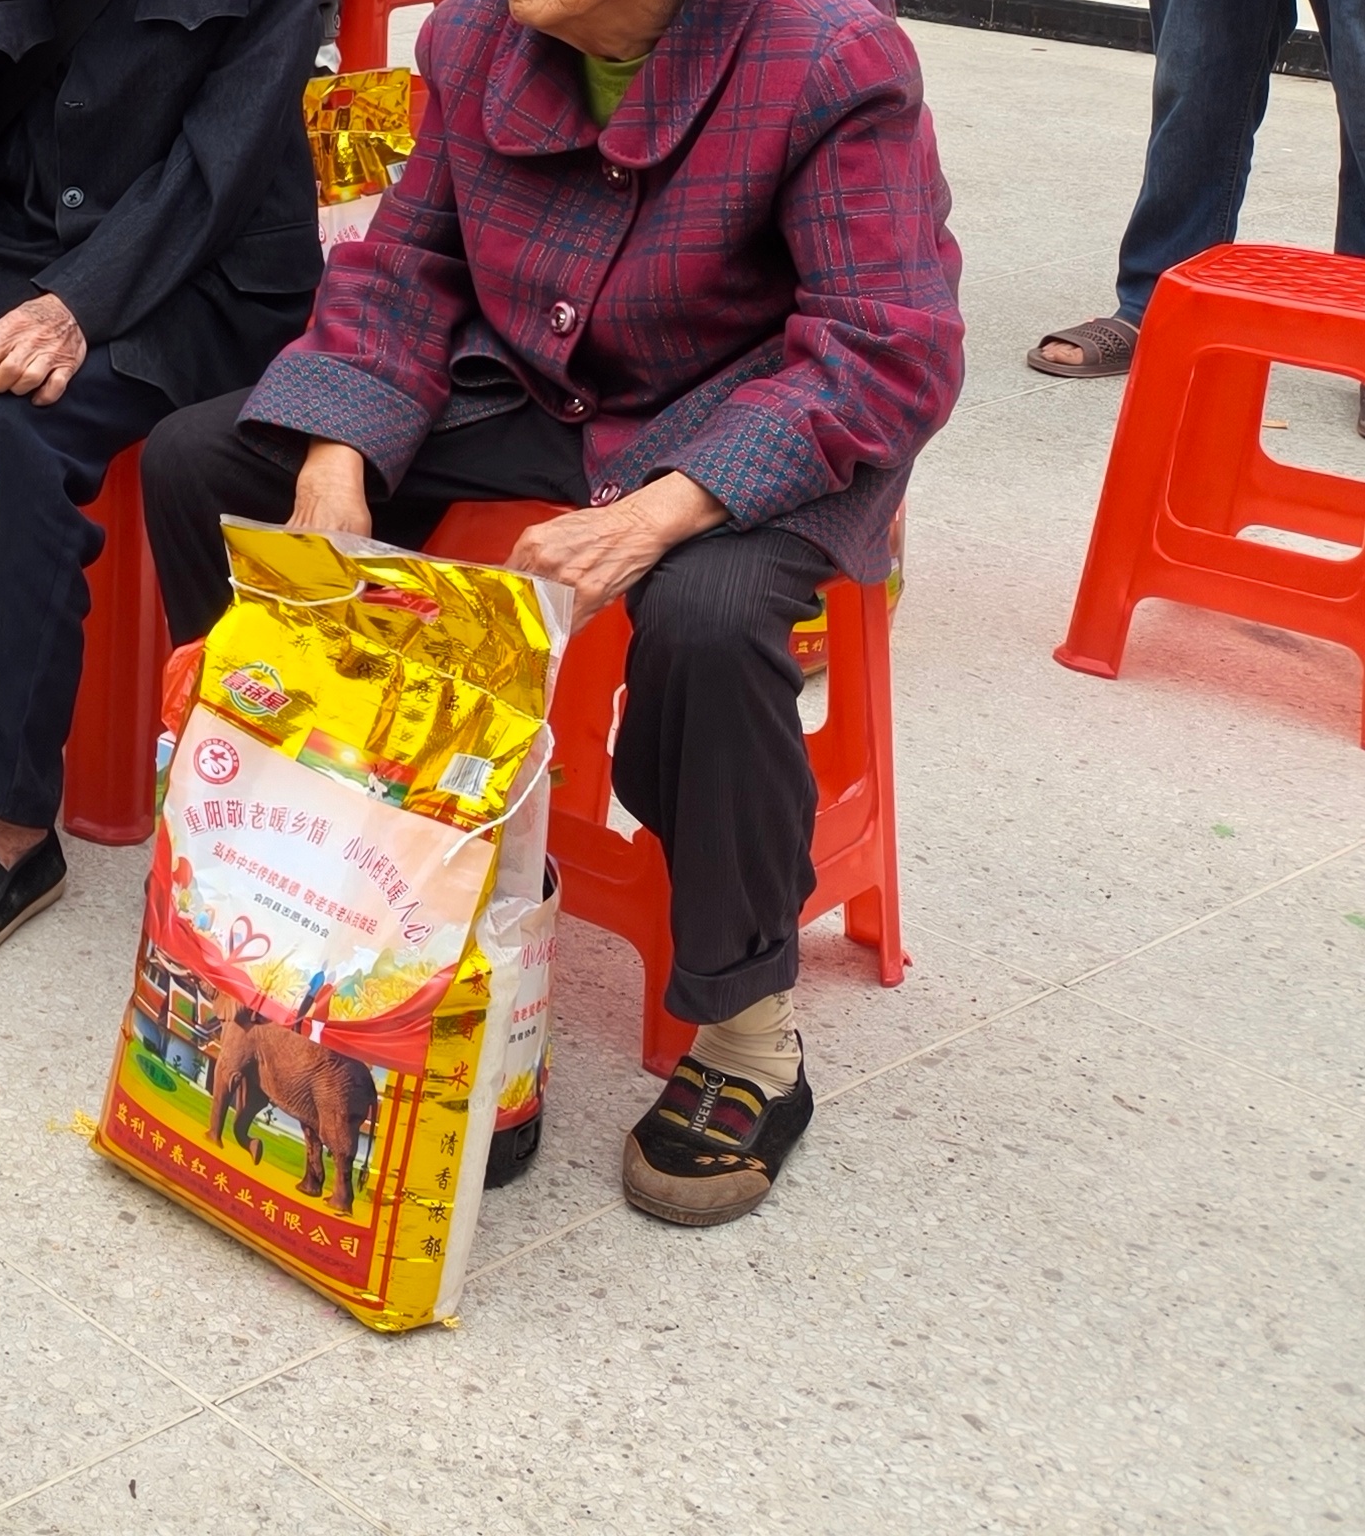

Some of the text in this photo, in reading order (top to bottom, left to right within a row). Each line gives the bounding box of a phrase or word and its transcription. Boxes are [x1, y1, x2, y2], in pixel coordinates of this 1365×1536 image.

[182, 799, 437, 945] 重阳敬老暖乡情 小小相聚暖人心
[211, 840, 379, 936] 弘扬中华传统美德 敬老爱老从我做起
[252, 891, 331, 940] 会同县志愿者协会
[115, 1101, 361, 1259] 监利市春红米业有限公司
[419, 1130, 461, 1262] 清香浓郁
